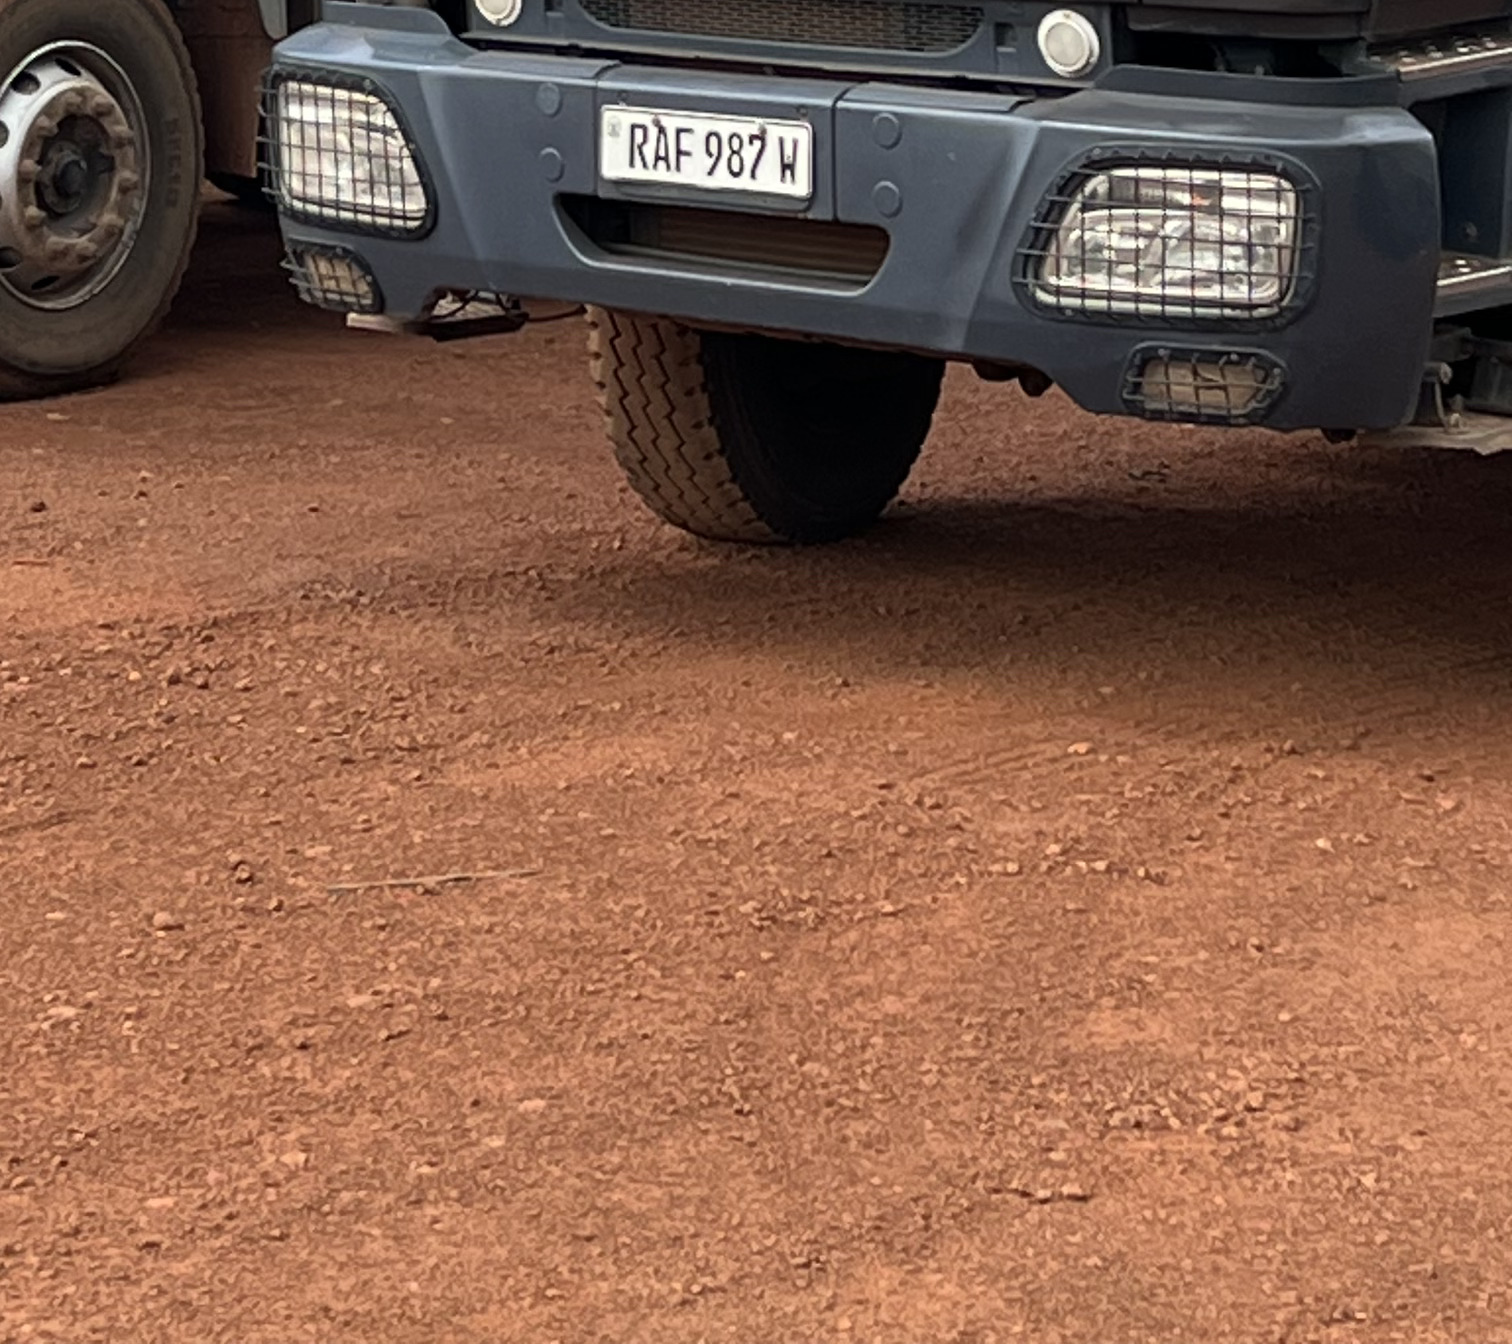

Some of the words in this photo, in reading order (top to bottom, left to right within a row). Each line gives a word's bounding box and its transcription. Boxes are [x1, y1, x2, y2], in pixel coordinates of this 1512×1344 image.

[629, 122, 695, 173] RAF
[705, 130, 767, 181] 987
[778, 135, 799, 186] W
